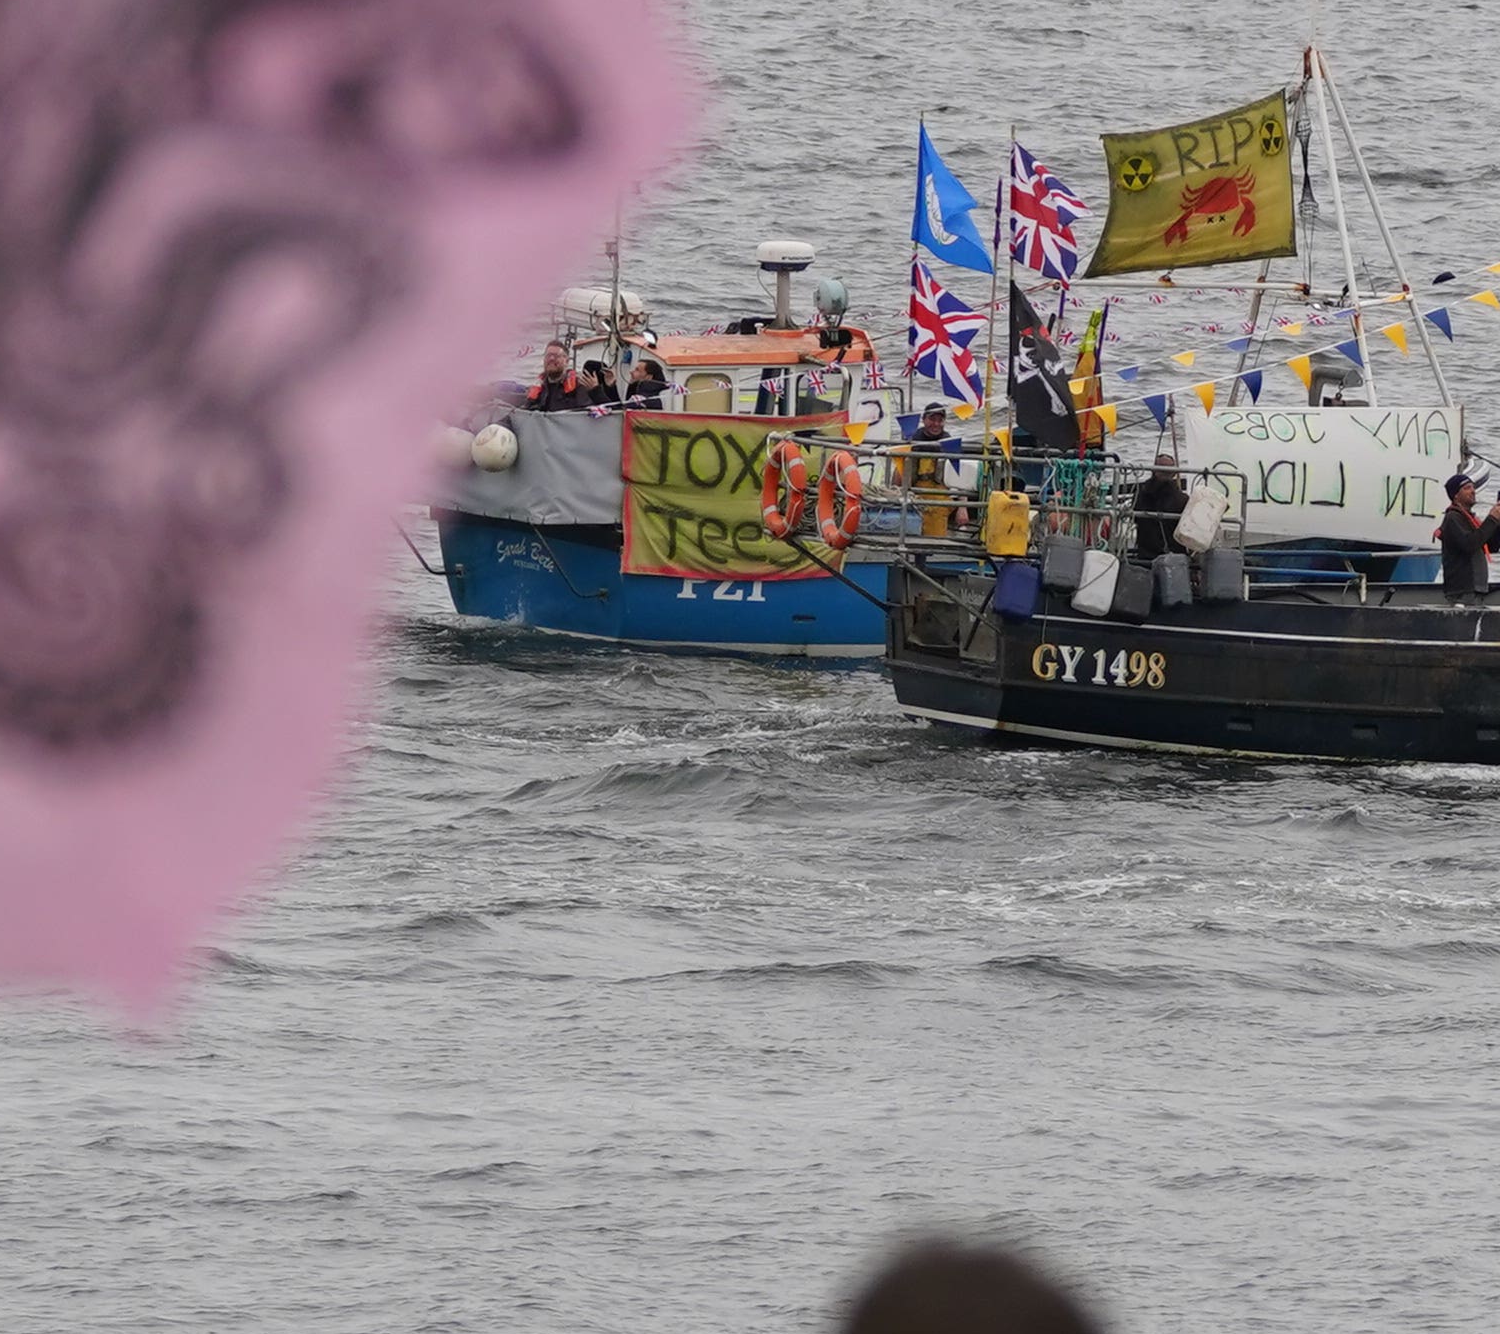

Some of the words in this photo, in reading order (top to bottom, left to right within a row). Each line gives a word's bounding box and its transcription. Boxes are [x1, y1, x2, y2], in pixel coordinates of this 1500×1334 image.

[1170, 117, 1256, 177] RIP
[633, 427, 770, 494] TOX
[1032, 643, 1086, 683] GY
[1091, 648, 1167, 690] 1498
